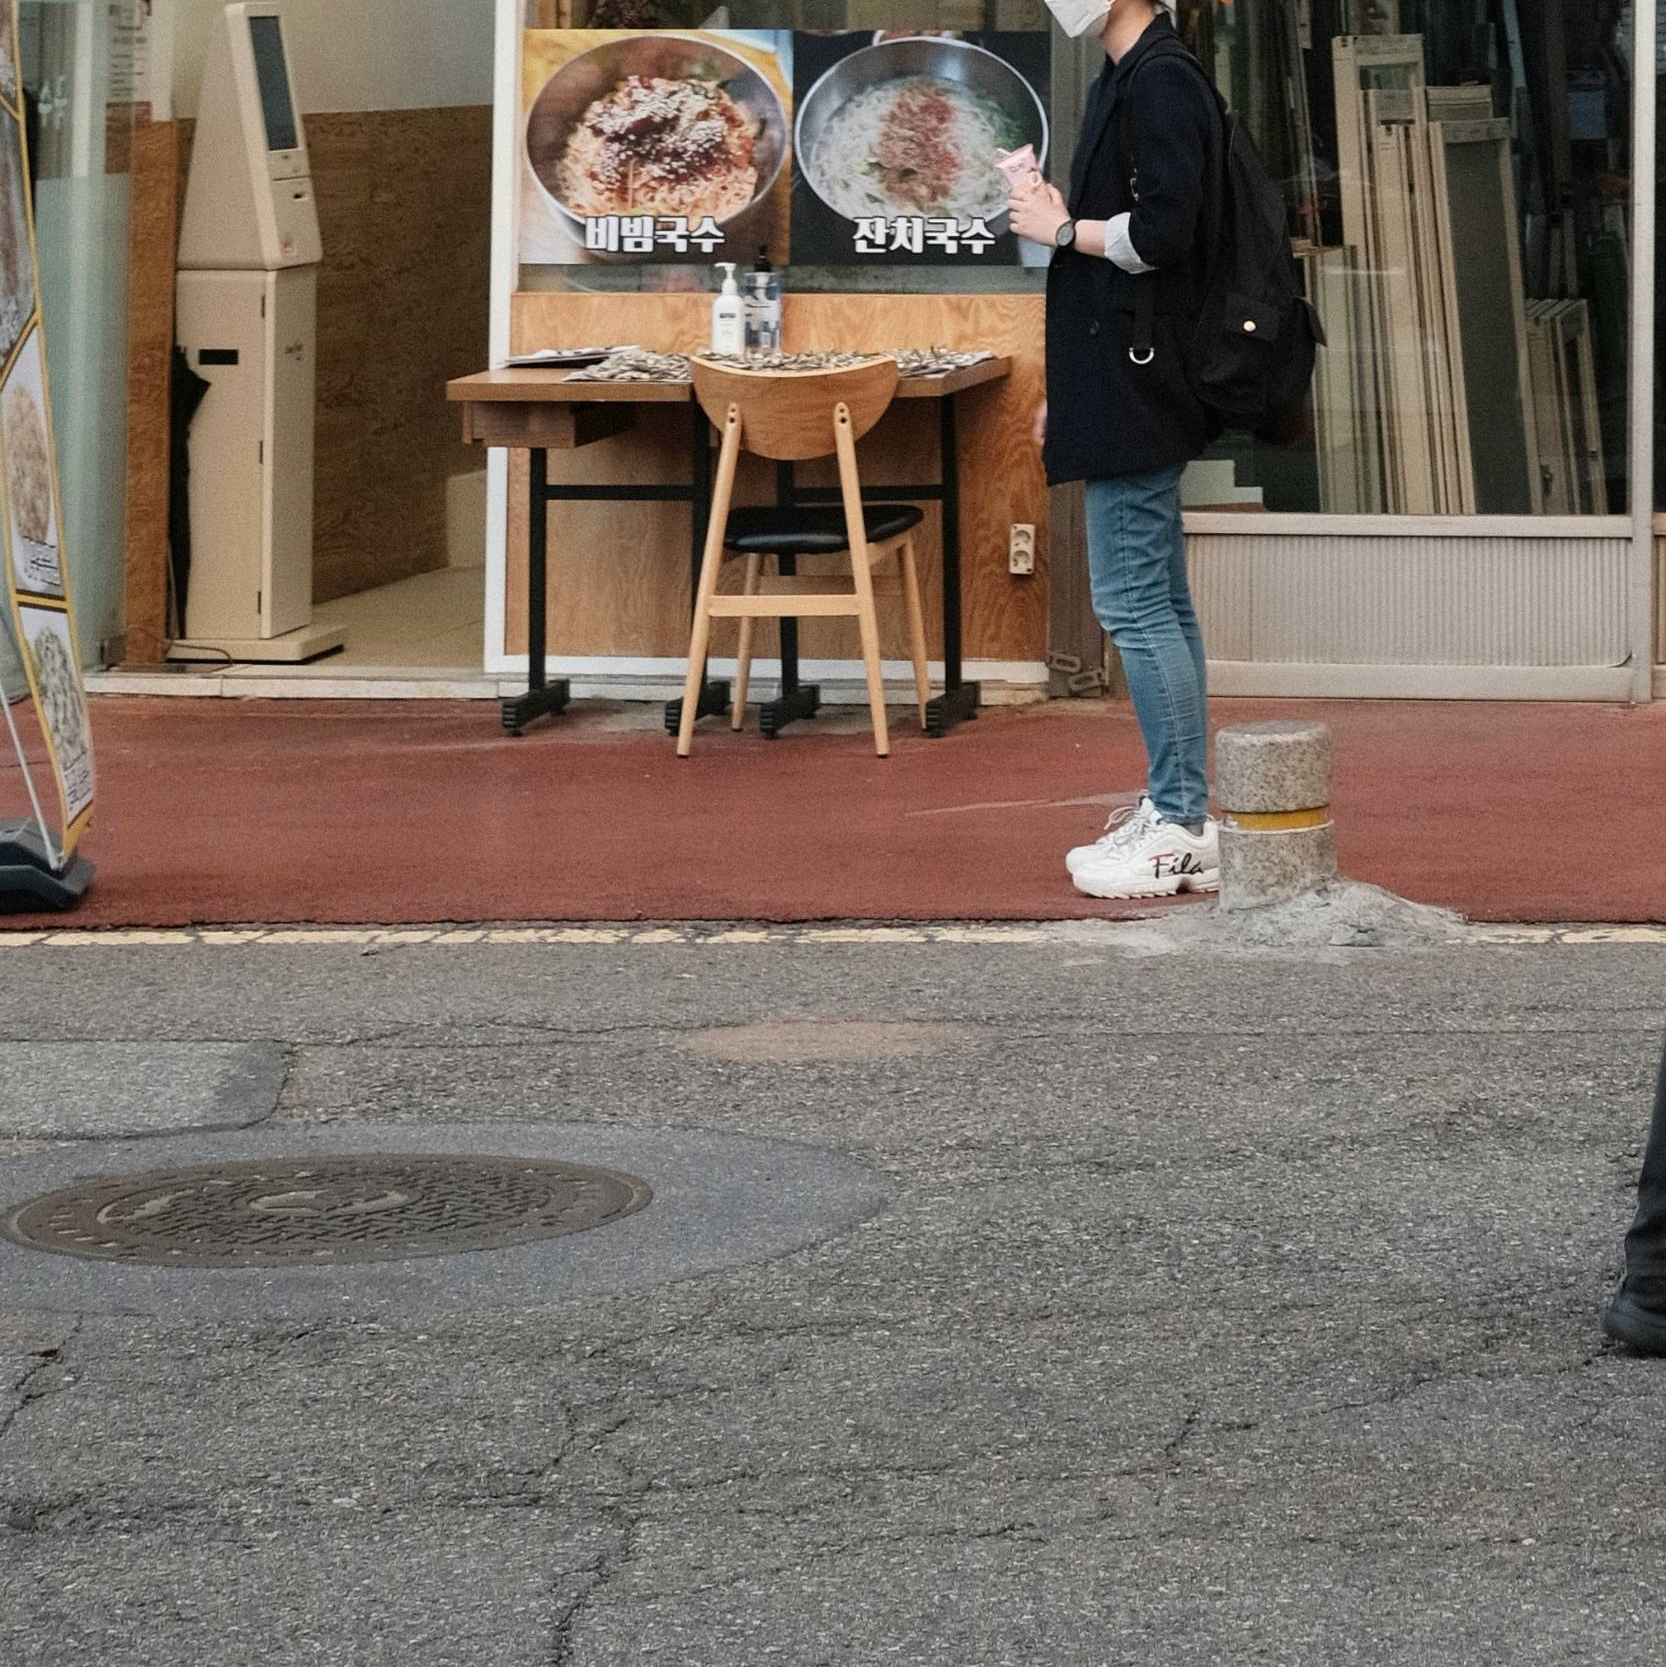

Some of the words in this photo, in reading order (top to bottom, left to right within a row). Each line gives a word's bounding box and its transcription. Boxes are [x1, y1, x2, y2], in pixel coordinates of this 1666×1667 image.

[584, 215, 726, 254] 비빔국수
[852, 216, 997, 255] 잔치국수
[1148, 852, 1204, 879] Fila
